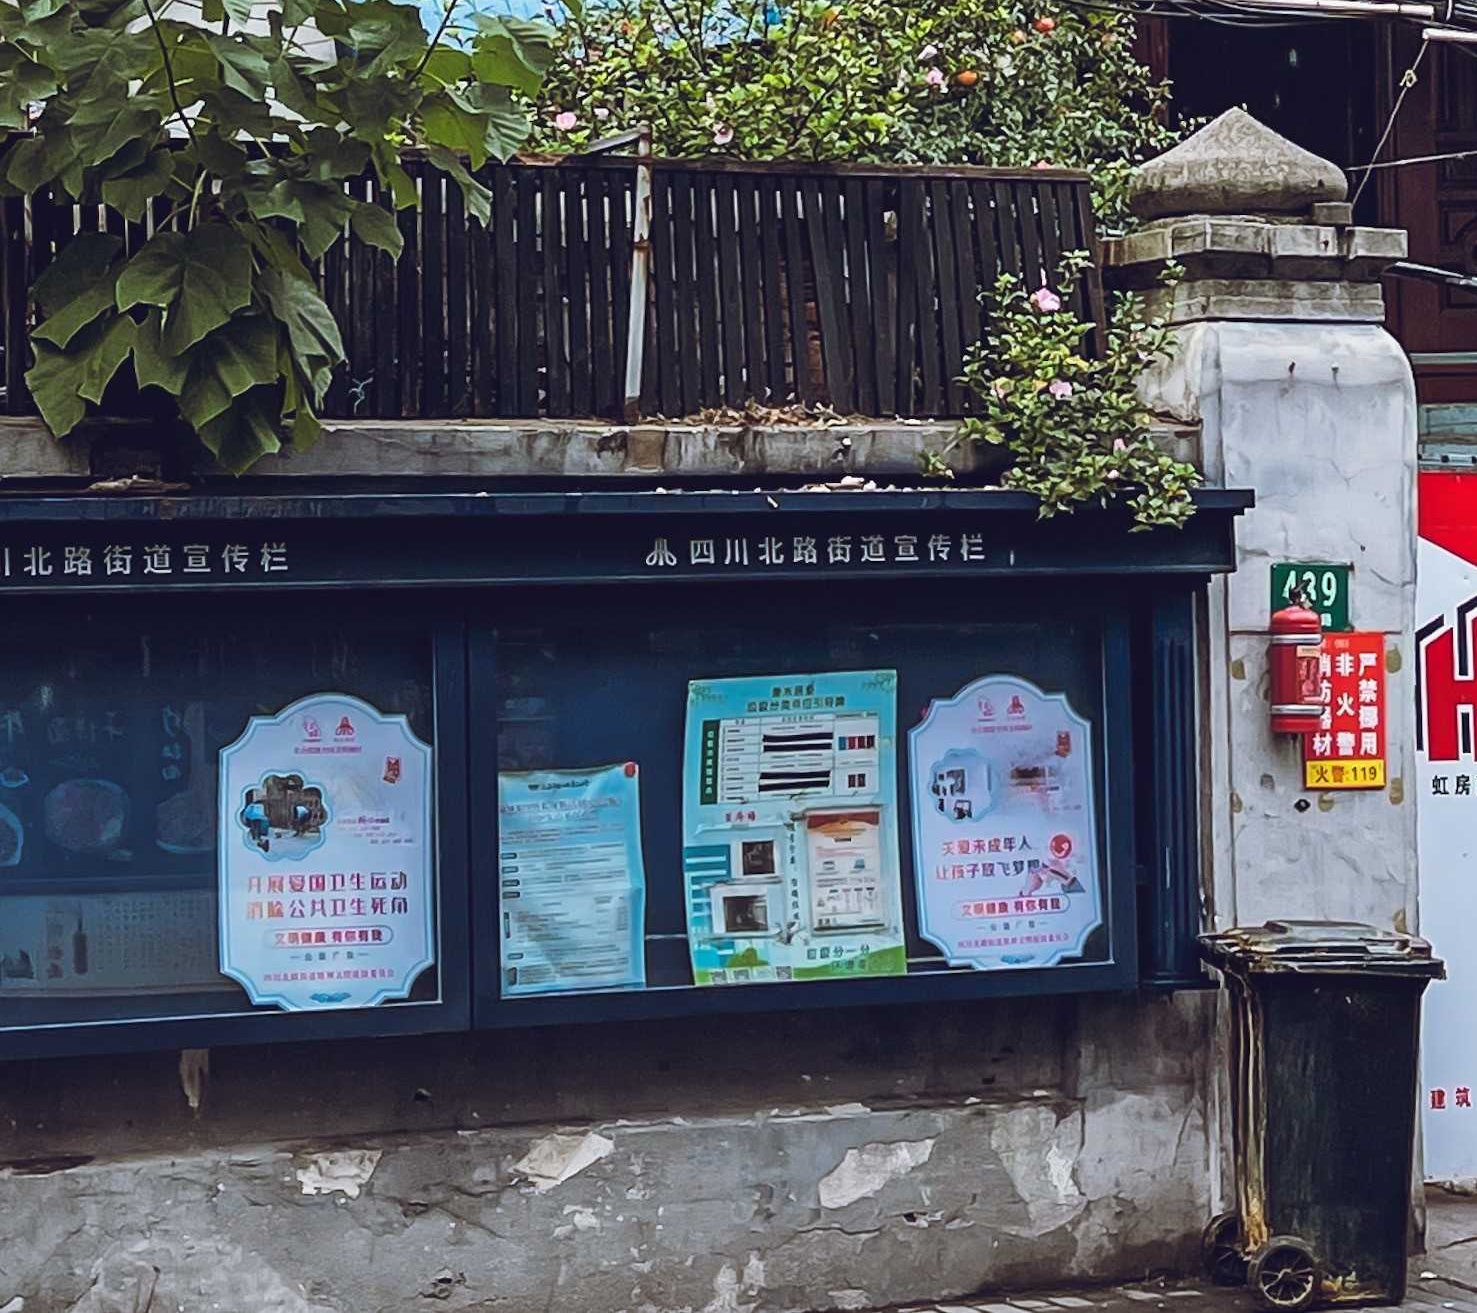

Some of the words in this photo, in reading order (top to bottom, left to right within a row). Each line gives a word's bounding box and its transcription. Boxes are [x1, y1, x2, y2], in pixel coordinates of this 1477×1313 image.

[690, 533, 985, 566] 四川北路街道宣传栏
[1335, 652, 1356, 756] 非火警
[1430, 1087, 1472, 1109] 建筑
